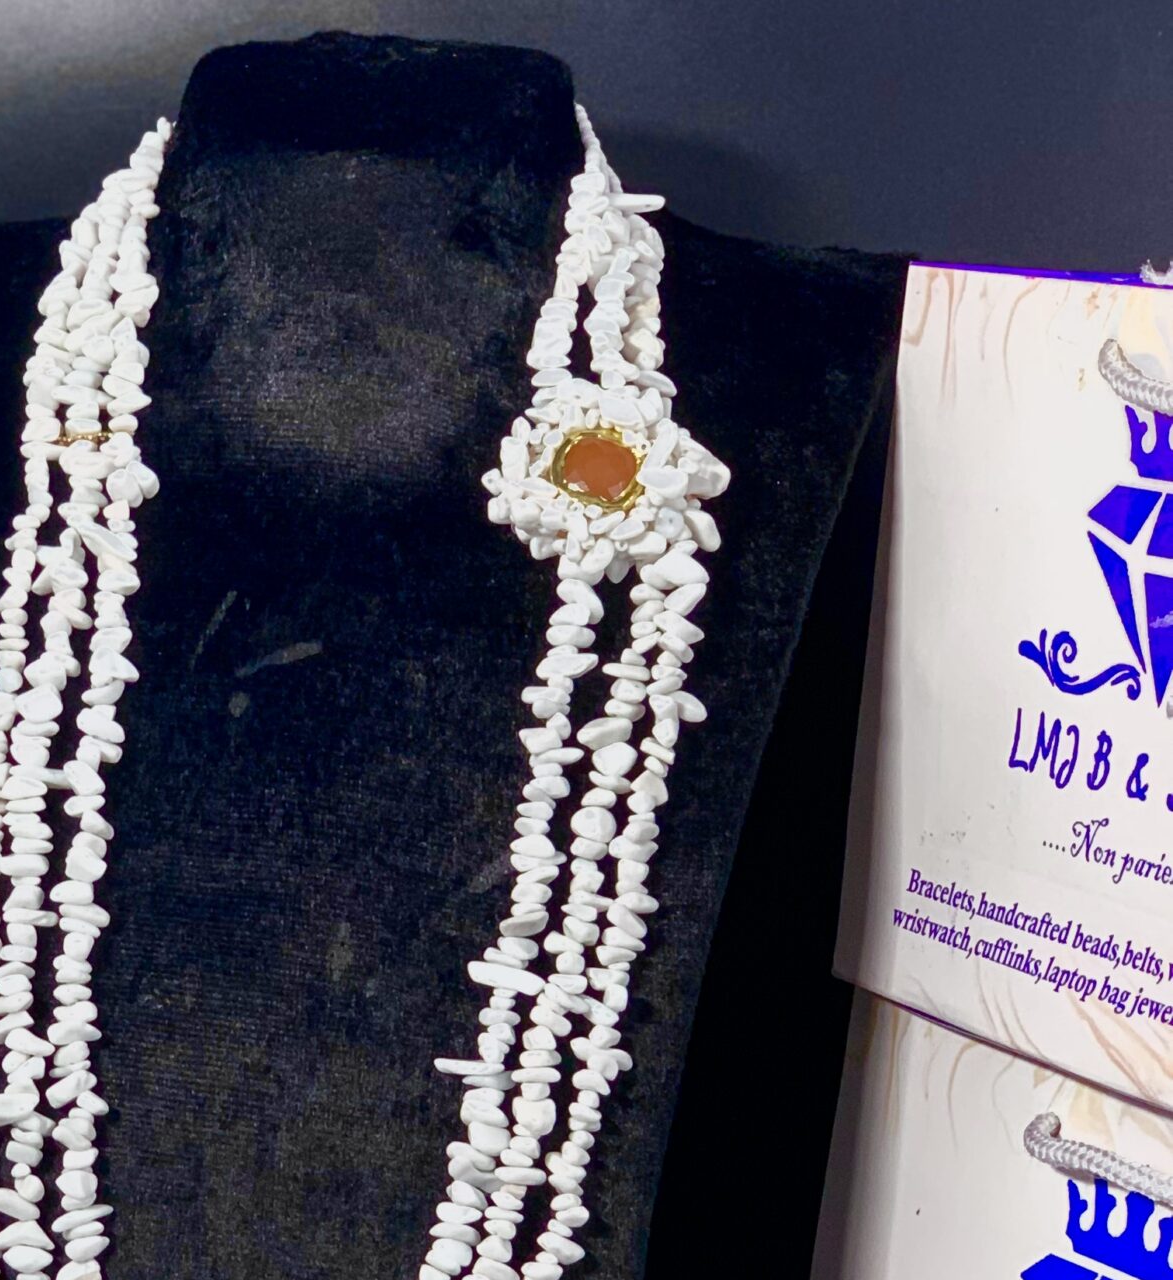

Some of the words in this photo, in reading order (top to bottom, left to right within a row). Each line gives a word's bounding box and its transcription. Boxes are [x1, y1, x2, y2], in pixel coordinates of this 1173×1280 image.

[1086, 729, 1113, 791] B
[1126, 752, 1149, 802] &
[1111, 853, 1173, 885] parie
[1097, 975, 1130, 1015] bag
[1125, 986, 1173, 1027] jewe
